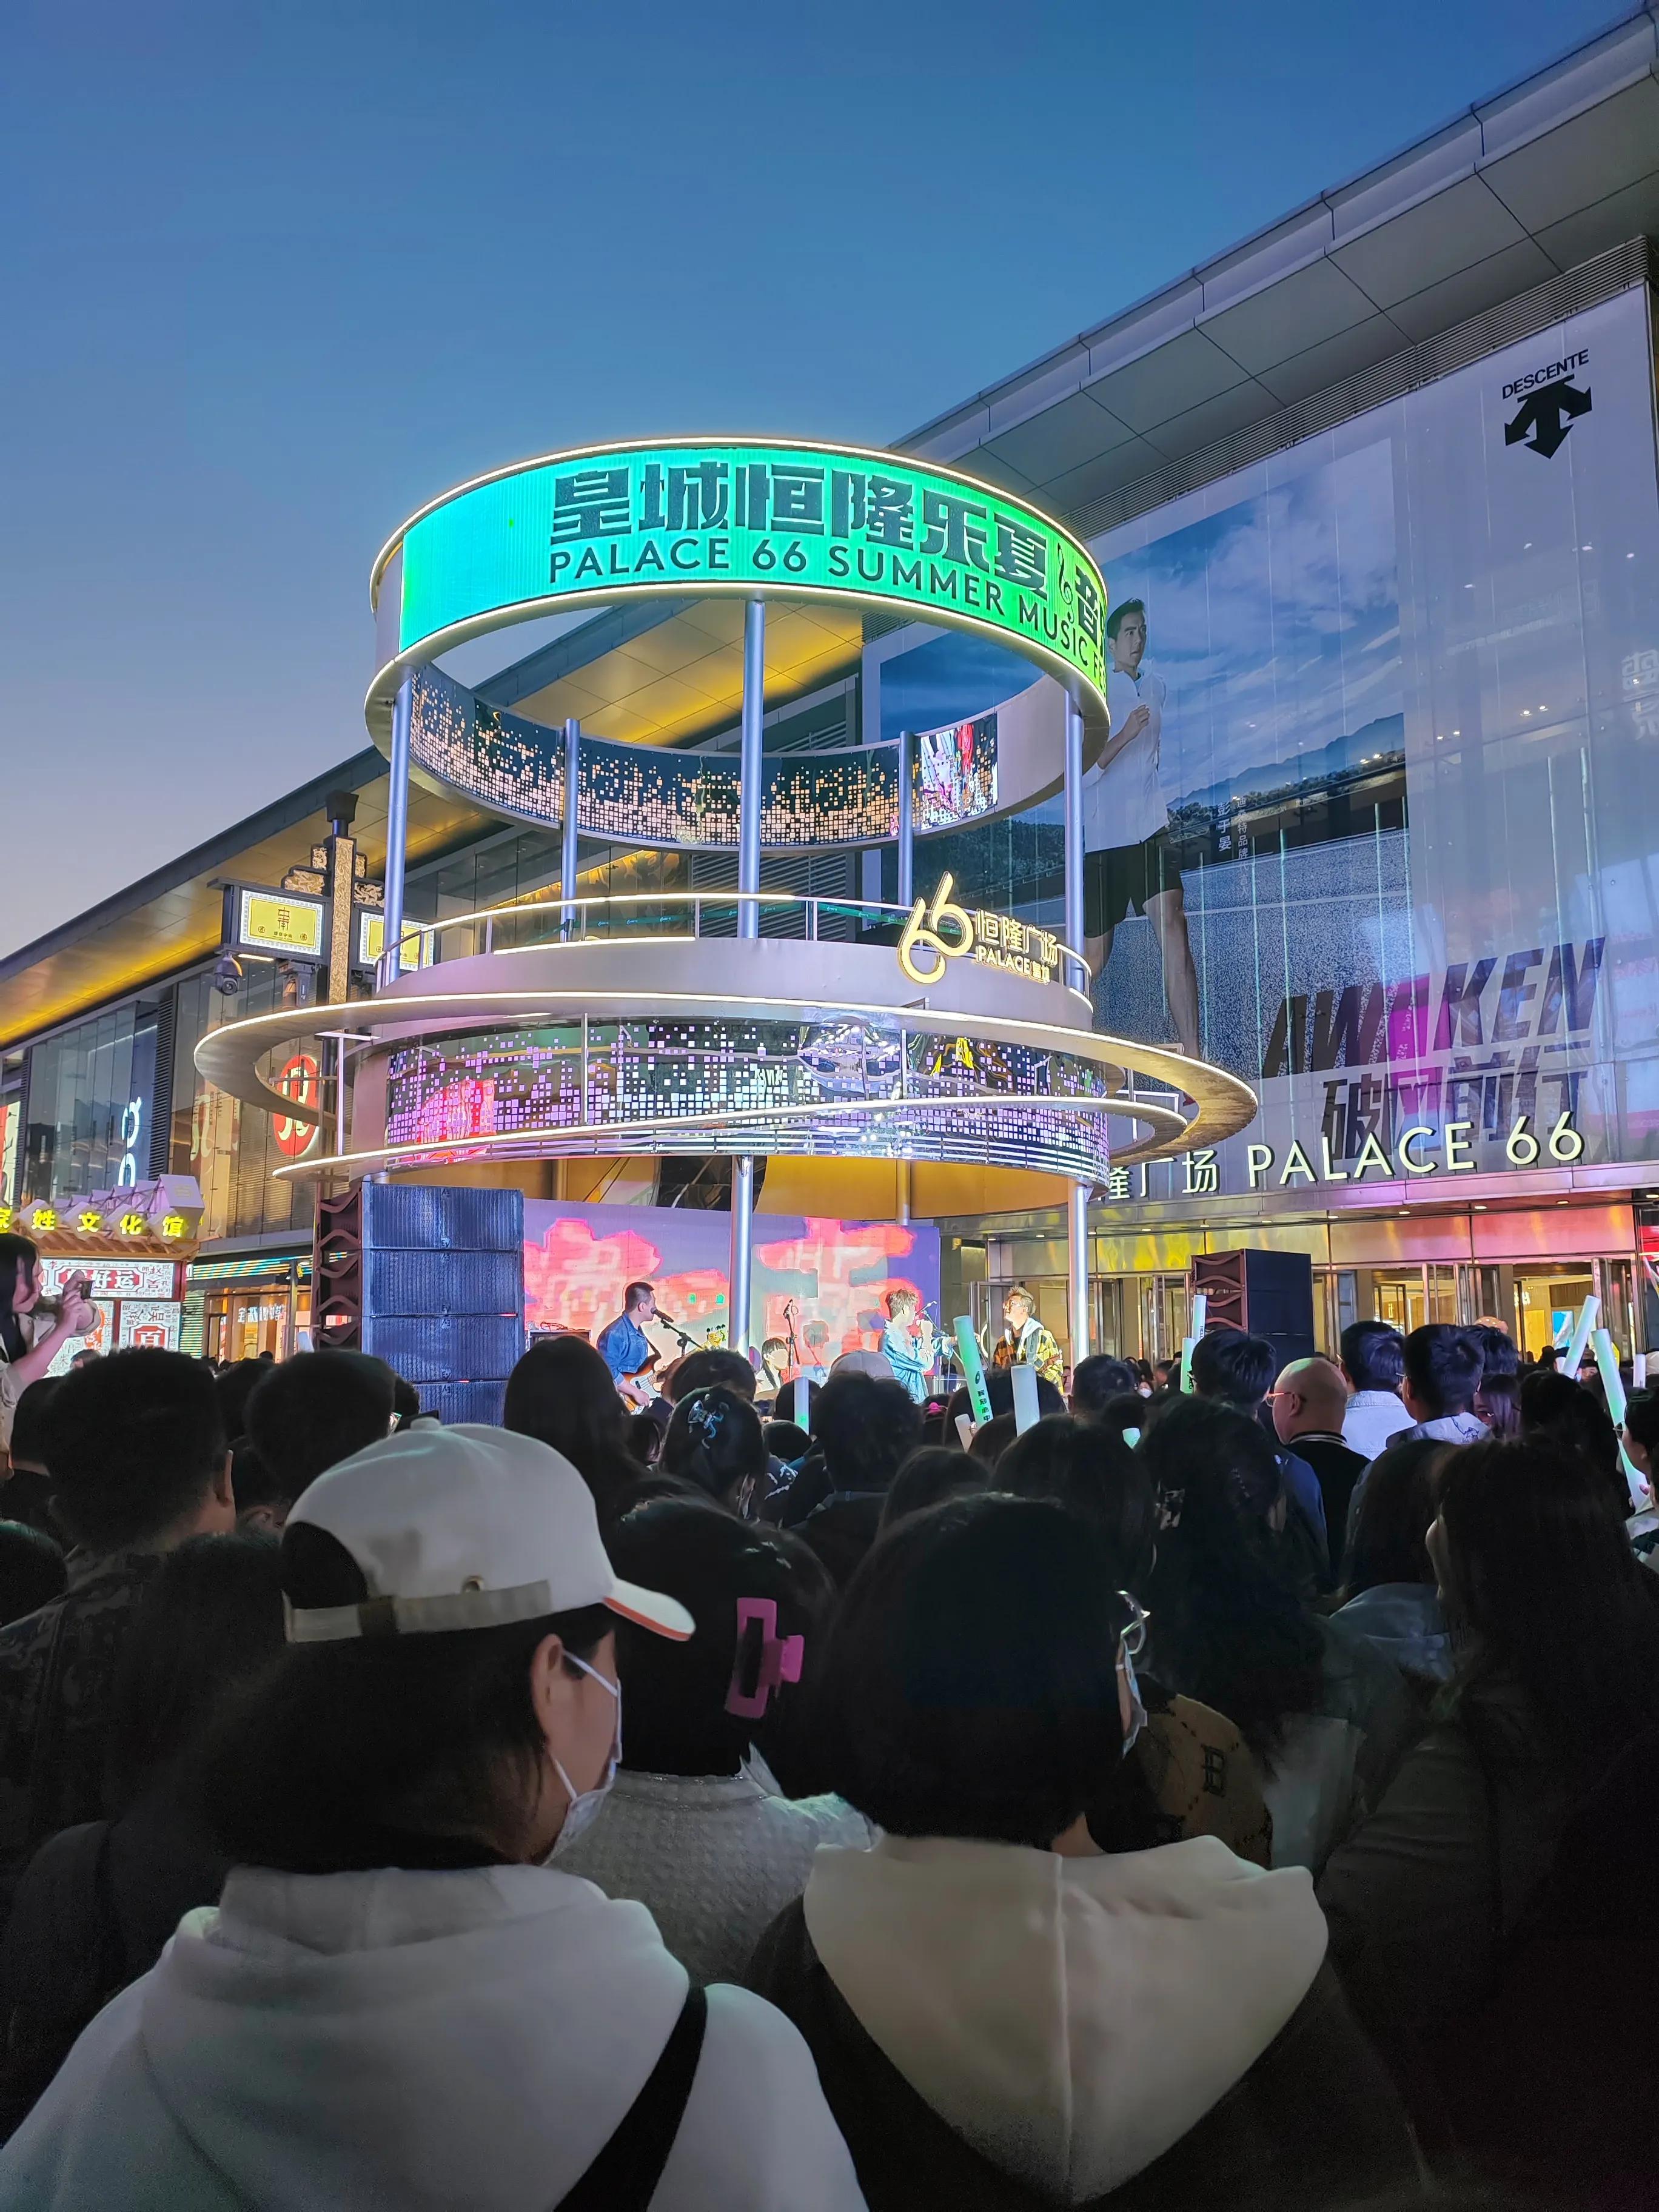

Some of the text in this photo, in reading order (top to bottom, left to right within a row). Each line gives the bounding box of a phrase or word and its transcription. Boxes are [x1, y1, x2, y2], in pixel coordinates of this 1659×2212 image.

[1502, 349, 1589, 400] DESCENTE
[550, 461, 1048, 600] 皇城恒隆乐夏
[549, 538, 729, 583] PALACE
[752, 539, 806, 572] 66
[828, 545, 1005, 616] SUMMER
[1018, 594, 1088, 666] MUSIC
[1218, 801, 1232, 851] 彭于晏
[976, 908, 1059, 967] 恒隆广场
[976, 945, 1031, 975] PALACE
[1262, 937, 1606, 1079] AWAKEN
[1248, 1112, 1585, 1187] PALACE 66
[67, 1269, 135, 1290] 好运
